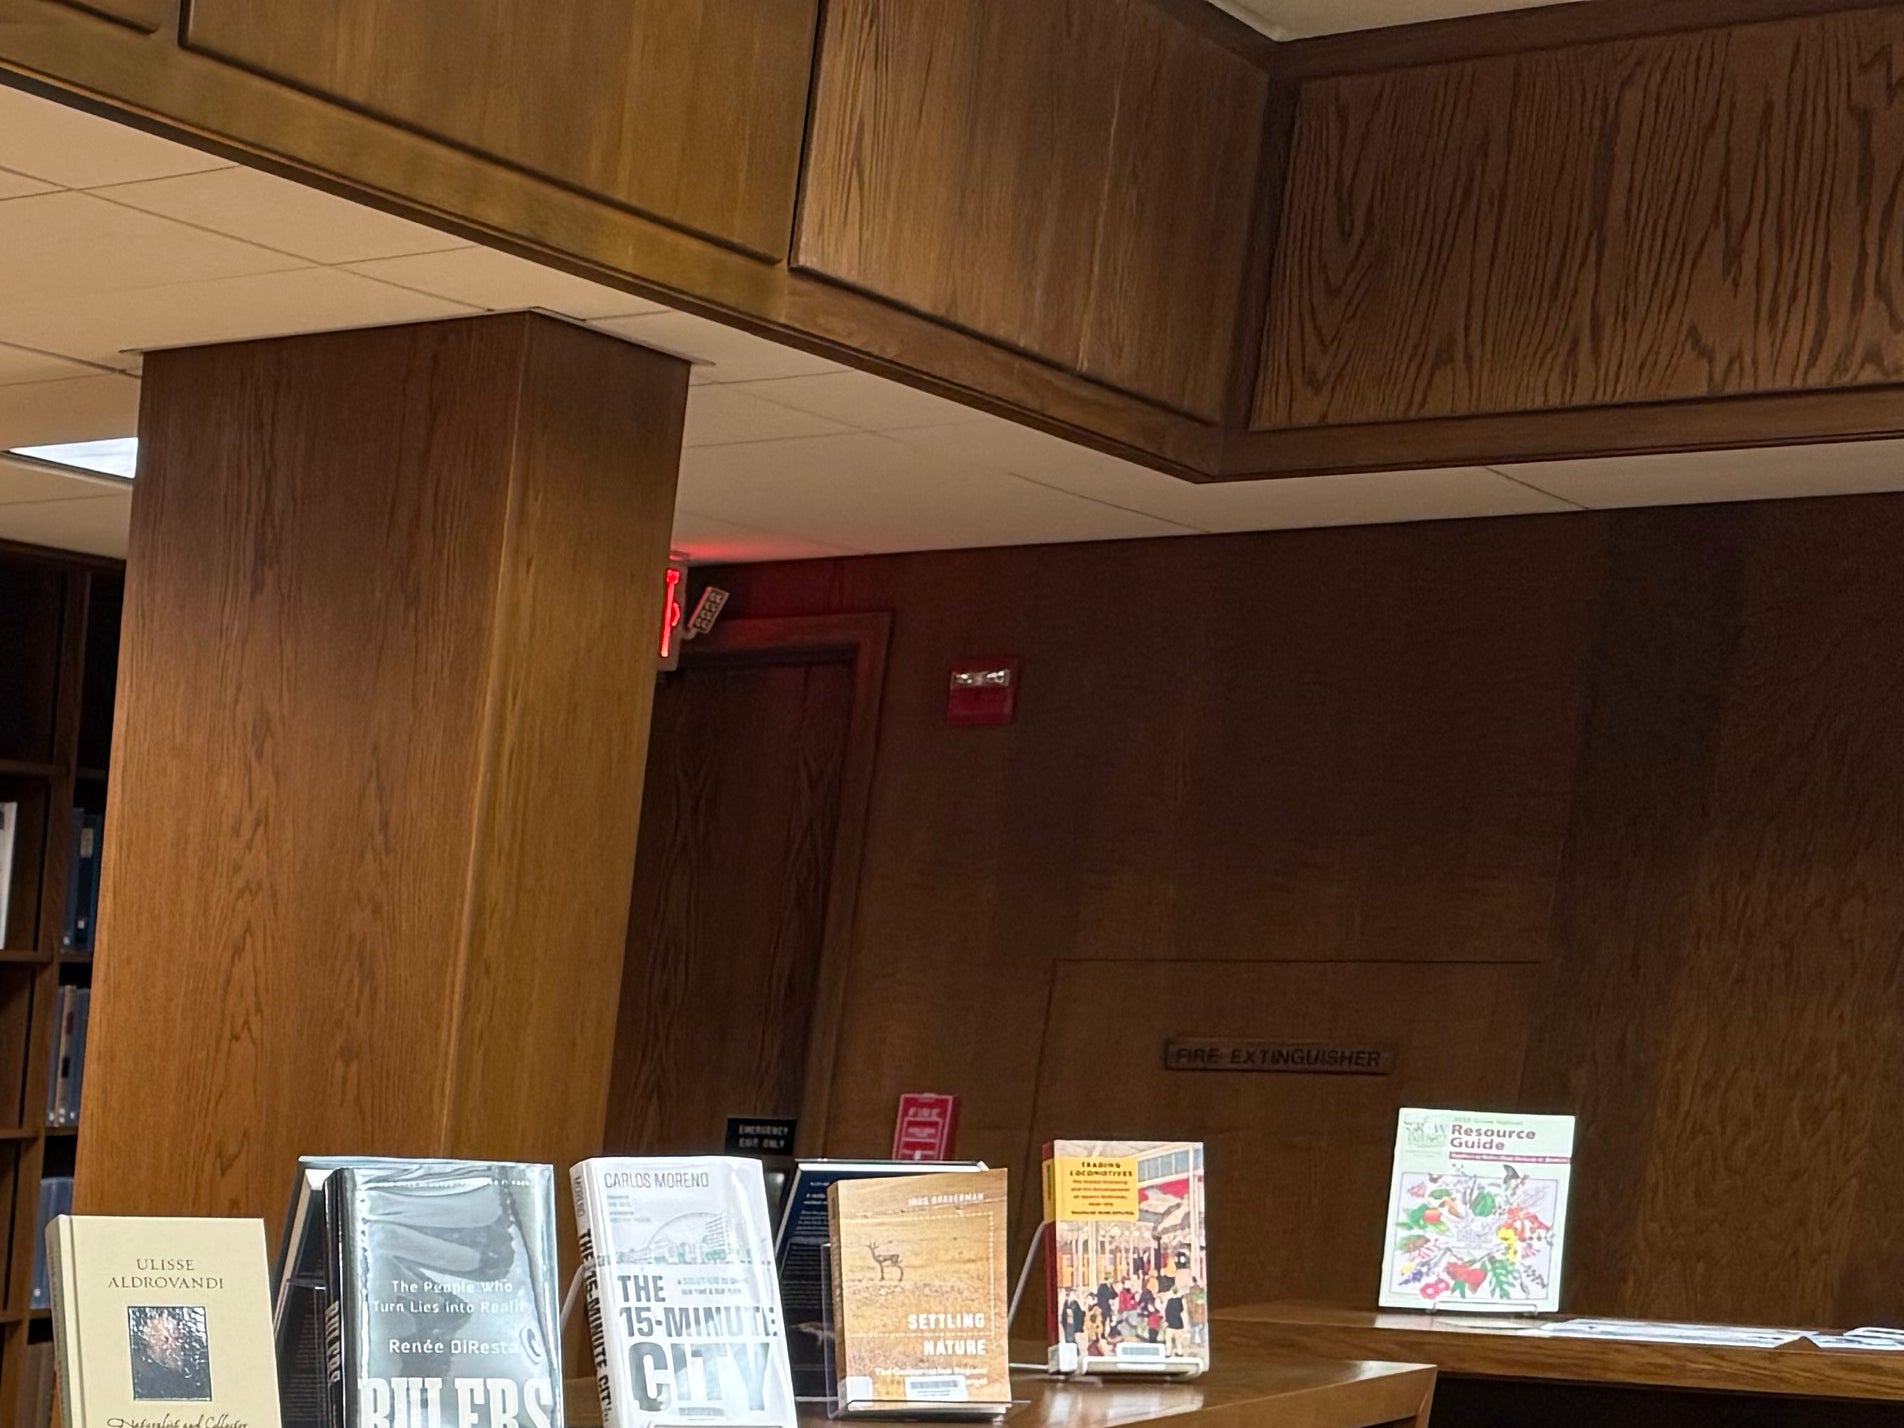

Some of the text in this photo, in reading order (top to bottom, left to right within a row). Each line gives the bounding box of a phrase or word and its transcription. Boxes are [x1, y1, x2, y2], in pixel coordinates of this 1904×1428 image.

[1175, 1047, 1382, 1068] FIRE EXTINGUISHER
[739, 1125, 789, 1135] EMERGENCY
[1450, 1123, 1537, 1142] Resource
[762, 1139, 785, 1148] ONLY
[1449, 1137, 1505, 1152] Guide
[604, 1171, 709, 1190] CARLOS MORENO
[136, 1258, 195, 1272] ULISSE
[108, 1276, 224, 1290] ALDROVANDI
[618, 1275, 665, 1303] THE
[619, 1305, 779, 1338] 15-MINUTE
[907, 1313, 987, 1330] SETTLING
[923, 1341, 987, 1356] NATURE
[627, 1341, 771, 1412] CITY
